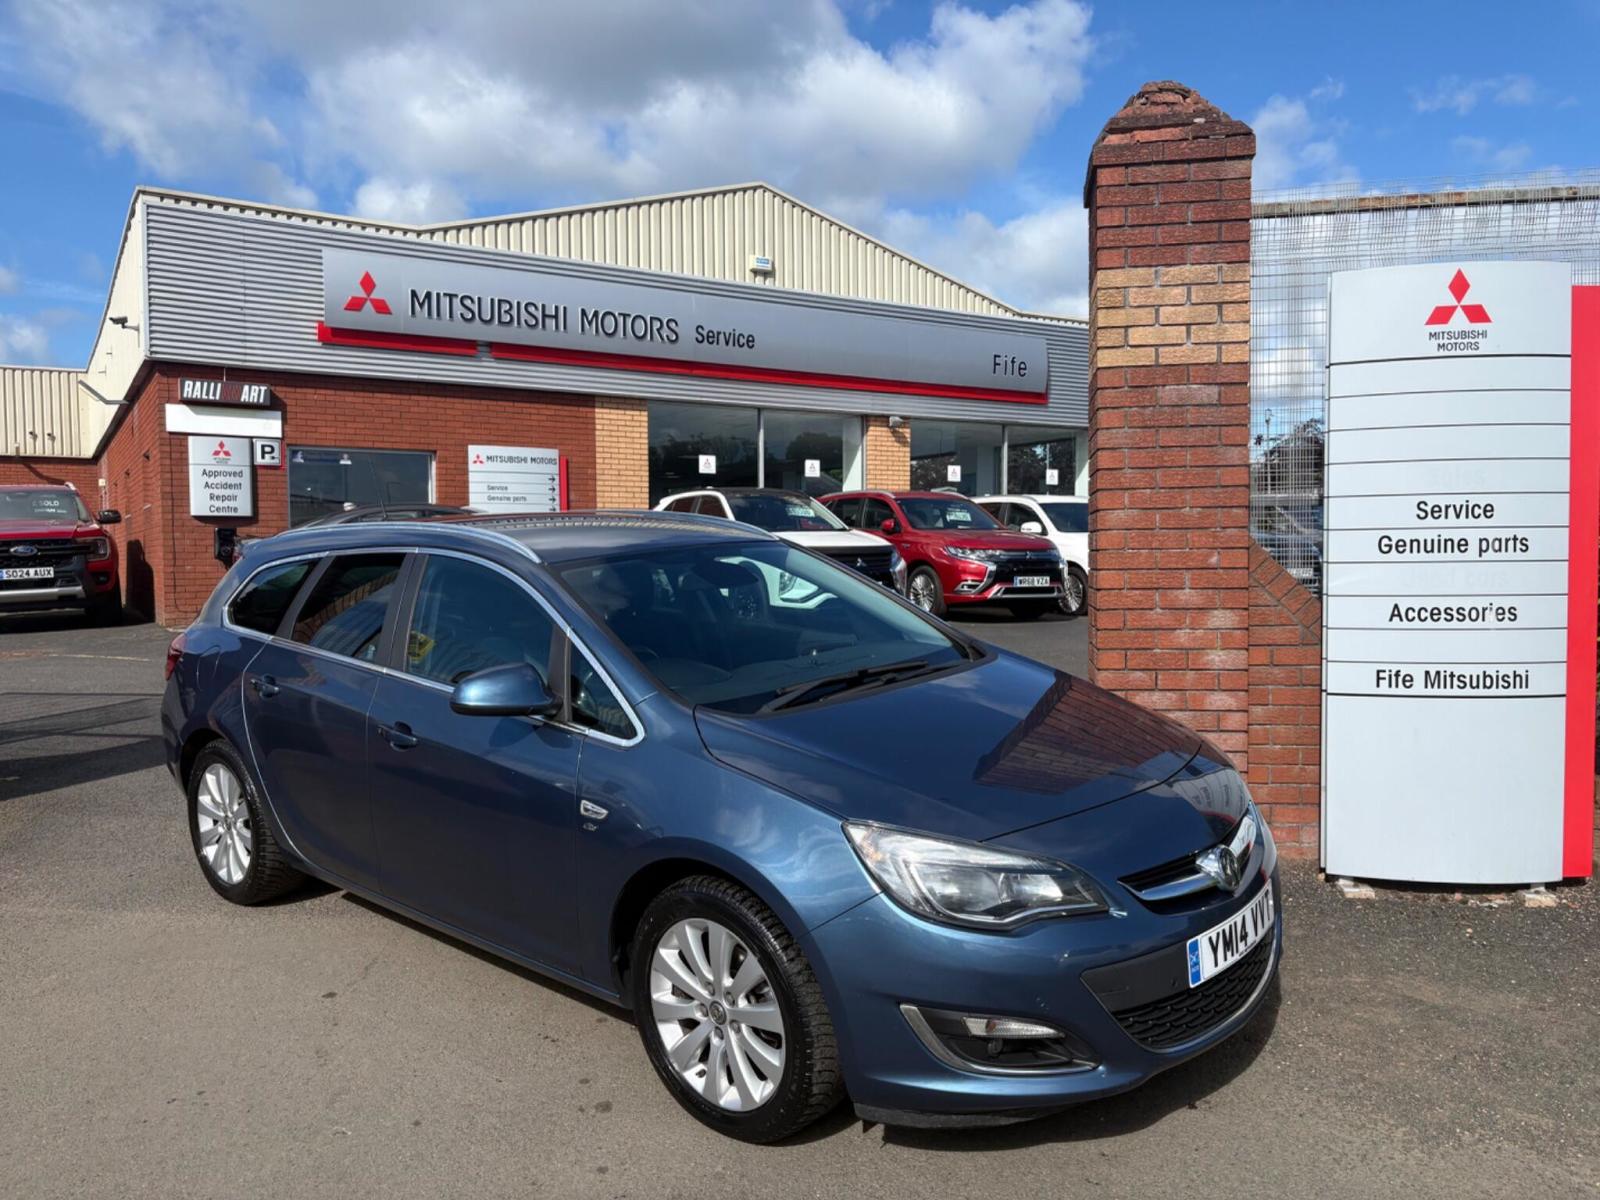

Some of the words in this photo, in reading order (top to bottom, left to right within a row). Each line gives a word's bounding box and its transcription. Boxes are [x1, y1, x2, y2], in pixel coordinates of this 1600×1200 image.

[409, 288, 567, 332] MITSUBISHI
[579, 307, 679, 344] MOTORS
[695, 324, 755, 349] Service
[1428, 329, 1488, 341] MITSUBISHI
[1437, 341, 1480, 352] MOTORS
[993, 354, 1027, 377] Fife
[486, 454, 528, 464] MITSUBISHI
[530, 456, 558, 465] MOTORS
[202, 469, 243, 479] Approved
[204, 481, 242, 490] Accident
[209, 493, 238, 503] Repair
[208, 504, 239, 513] Centre
[1416, 500, 1495, 520] Service
[1377, 534, 1469, 554] Genuine
[1478, 534, 1530, 558] parts
[34, 568, 52, 577] AUX
[1375, 669, 1414, 689] Fife
[1424, 669, 1529, 690] Mitsubishi
[1208, 914, 1249, 969] YM14
